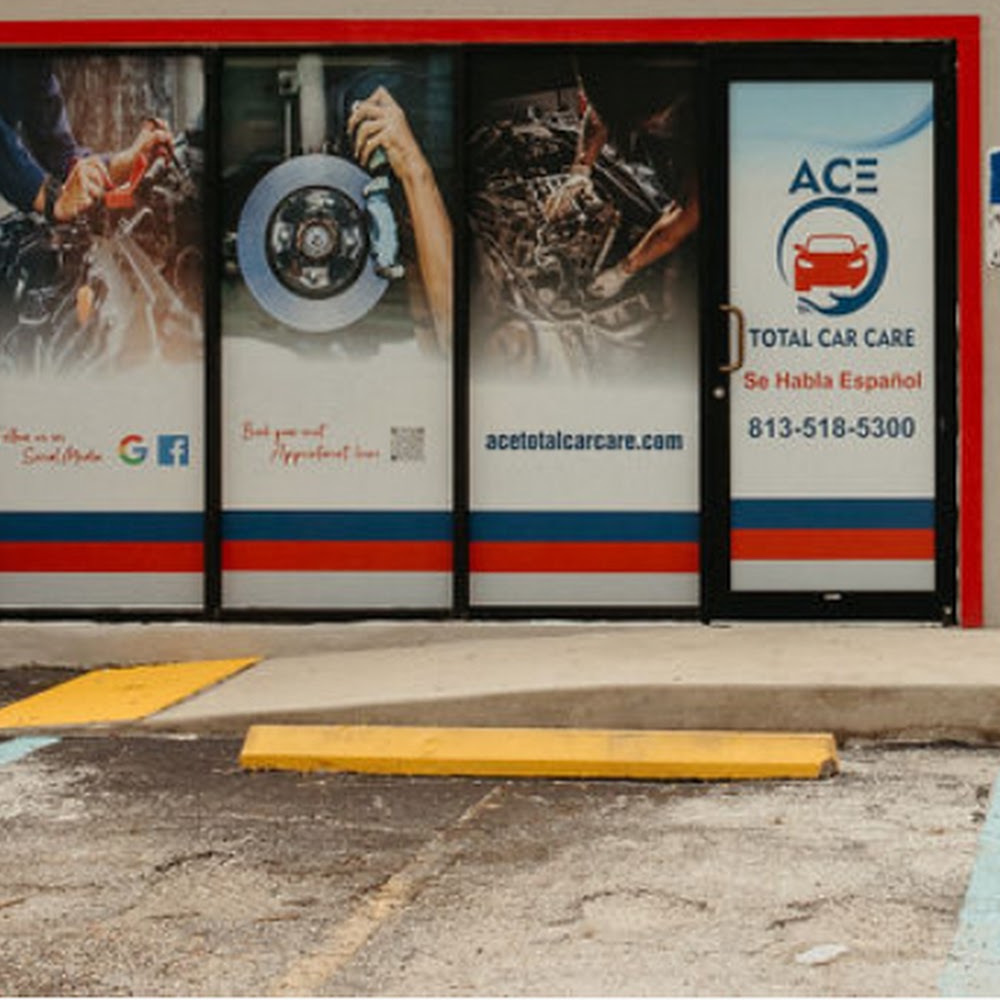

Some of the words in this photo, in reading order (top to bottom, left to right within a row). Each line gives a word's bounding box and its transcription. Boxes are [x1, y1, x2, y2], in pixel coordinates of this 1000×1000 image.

[788, 158, 878, 194] ACE
[749, 328, 813, 348] TOTAL
[818, 328, 857, 348] CAR
[864, 328, 915, 348] CARE
[744, 372, 769, 390] Se
[776, 371, 833, 390] Habla
[840, 371, 922, 393] Español
[749, 416, 916, 439] 813-518-5300
[485, 430, 684, 451] acetotalcarcare.com
